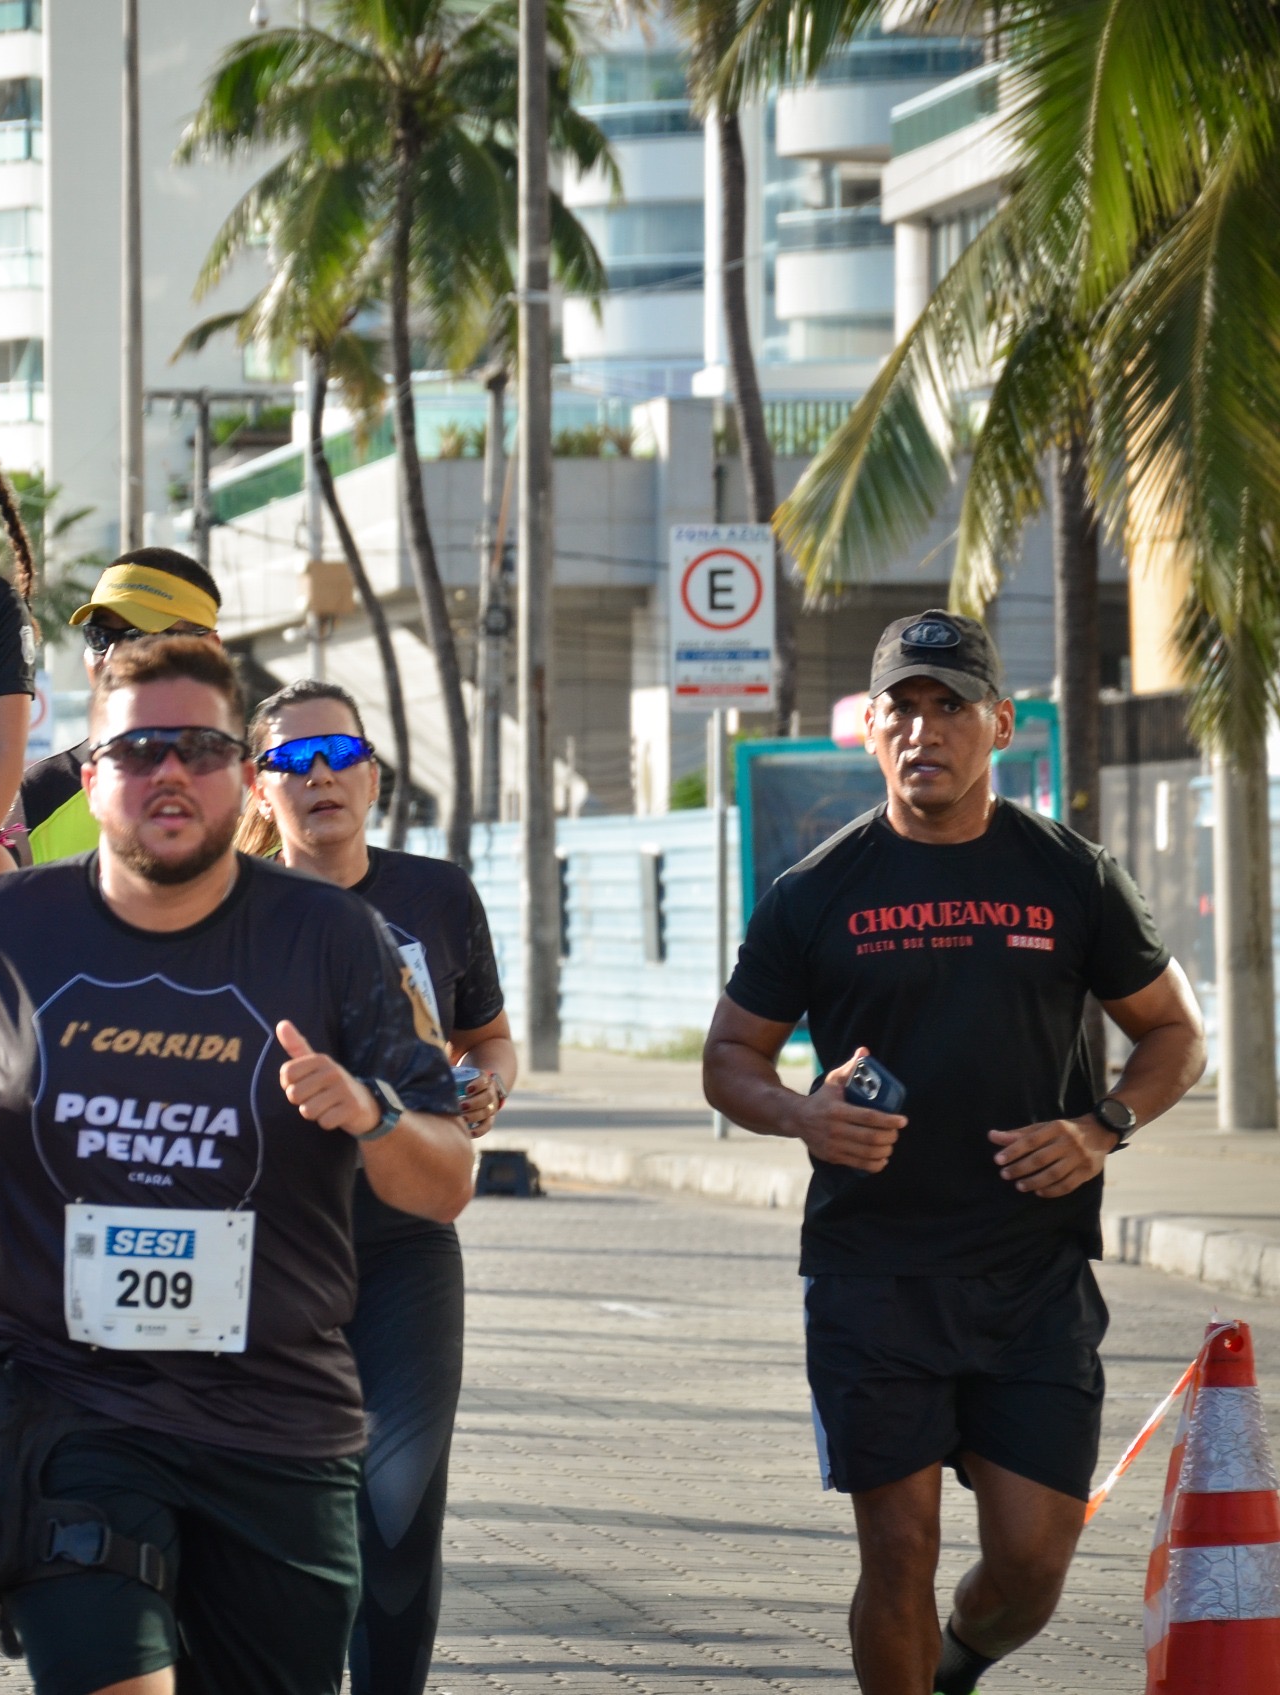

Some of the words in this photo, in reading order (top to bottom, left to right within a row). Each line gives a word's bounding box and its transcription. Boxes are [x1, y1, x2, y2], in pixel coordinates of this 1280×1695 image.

[708, 568, 735, 611] E
[848, 901, 1021, 936] CHOQUEANO
[1025, 905, 1055, 931] 19
[1011, 935, 1054, 951] BRASIL
[90, 1026, 243, 1063] CORRIDA
[76, 1129, 223, 1169] PENAL
[111, 1229, 190, 1257] SESI
[116, 1268, 193, 1310] 209
